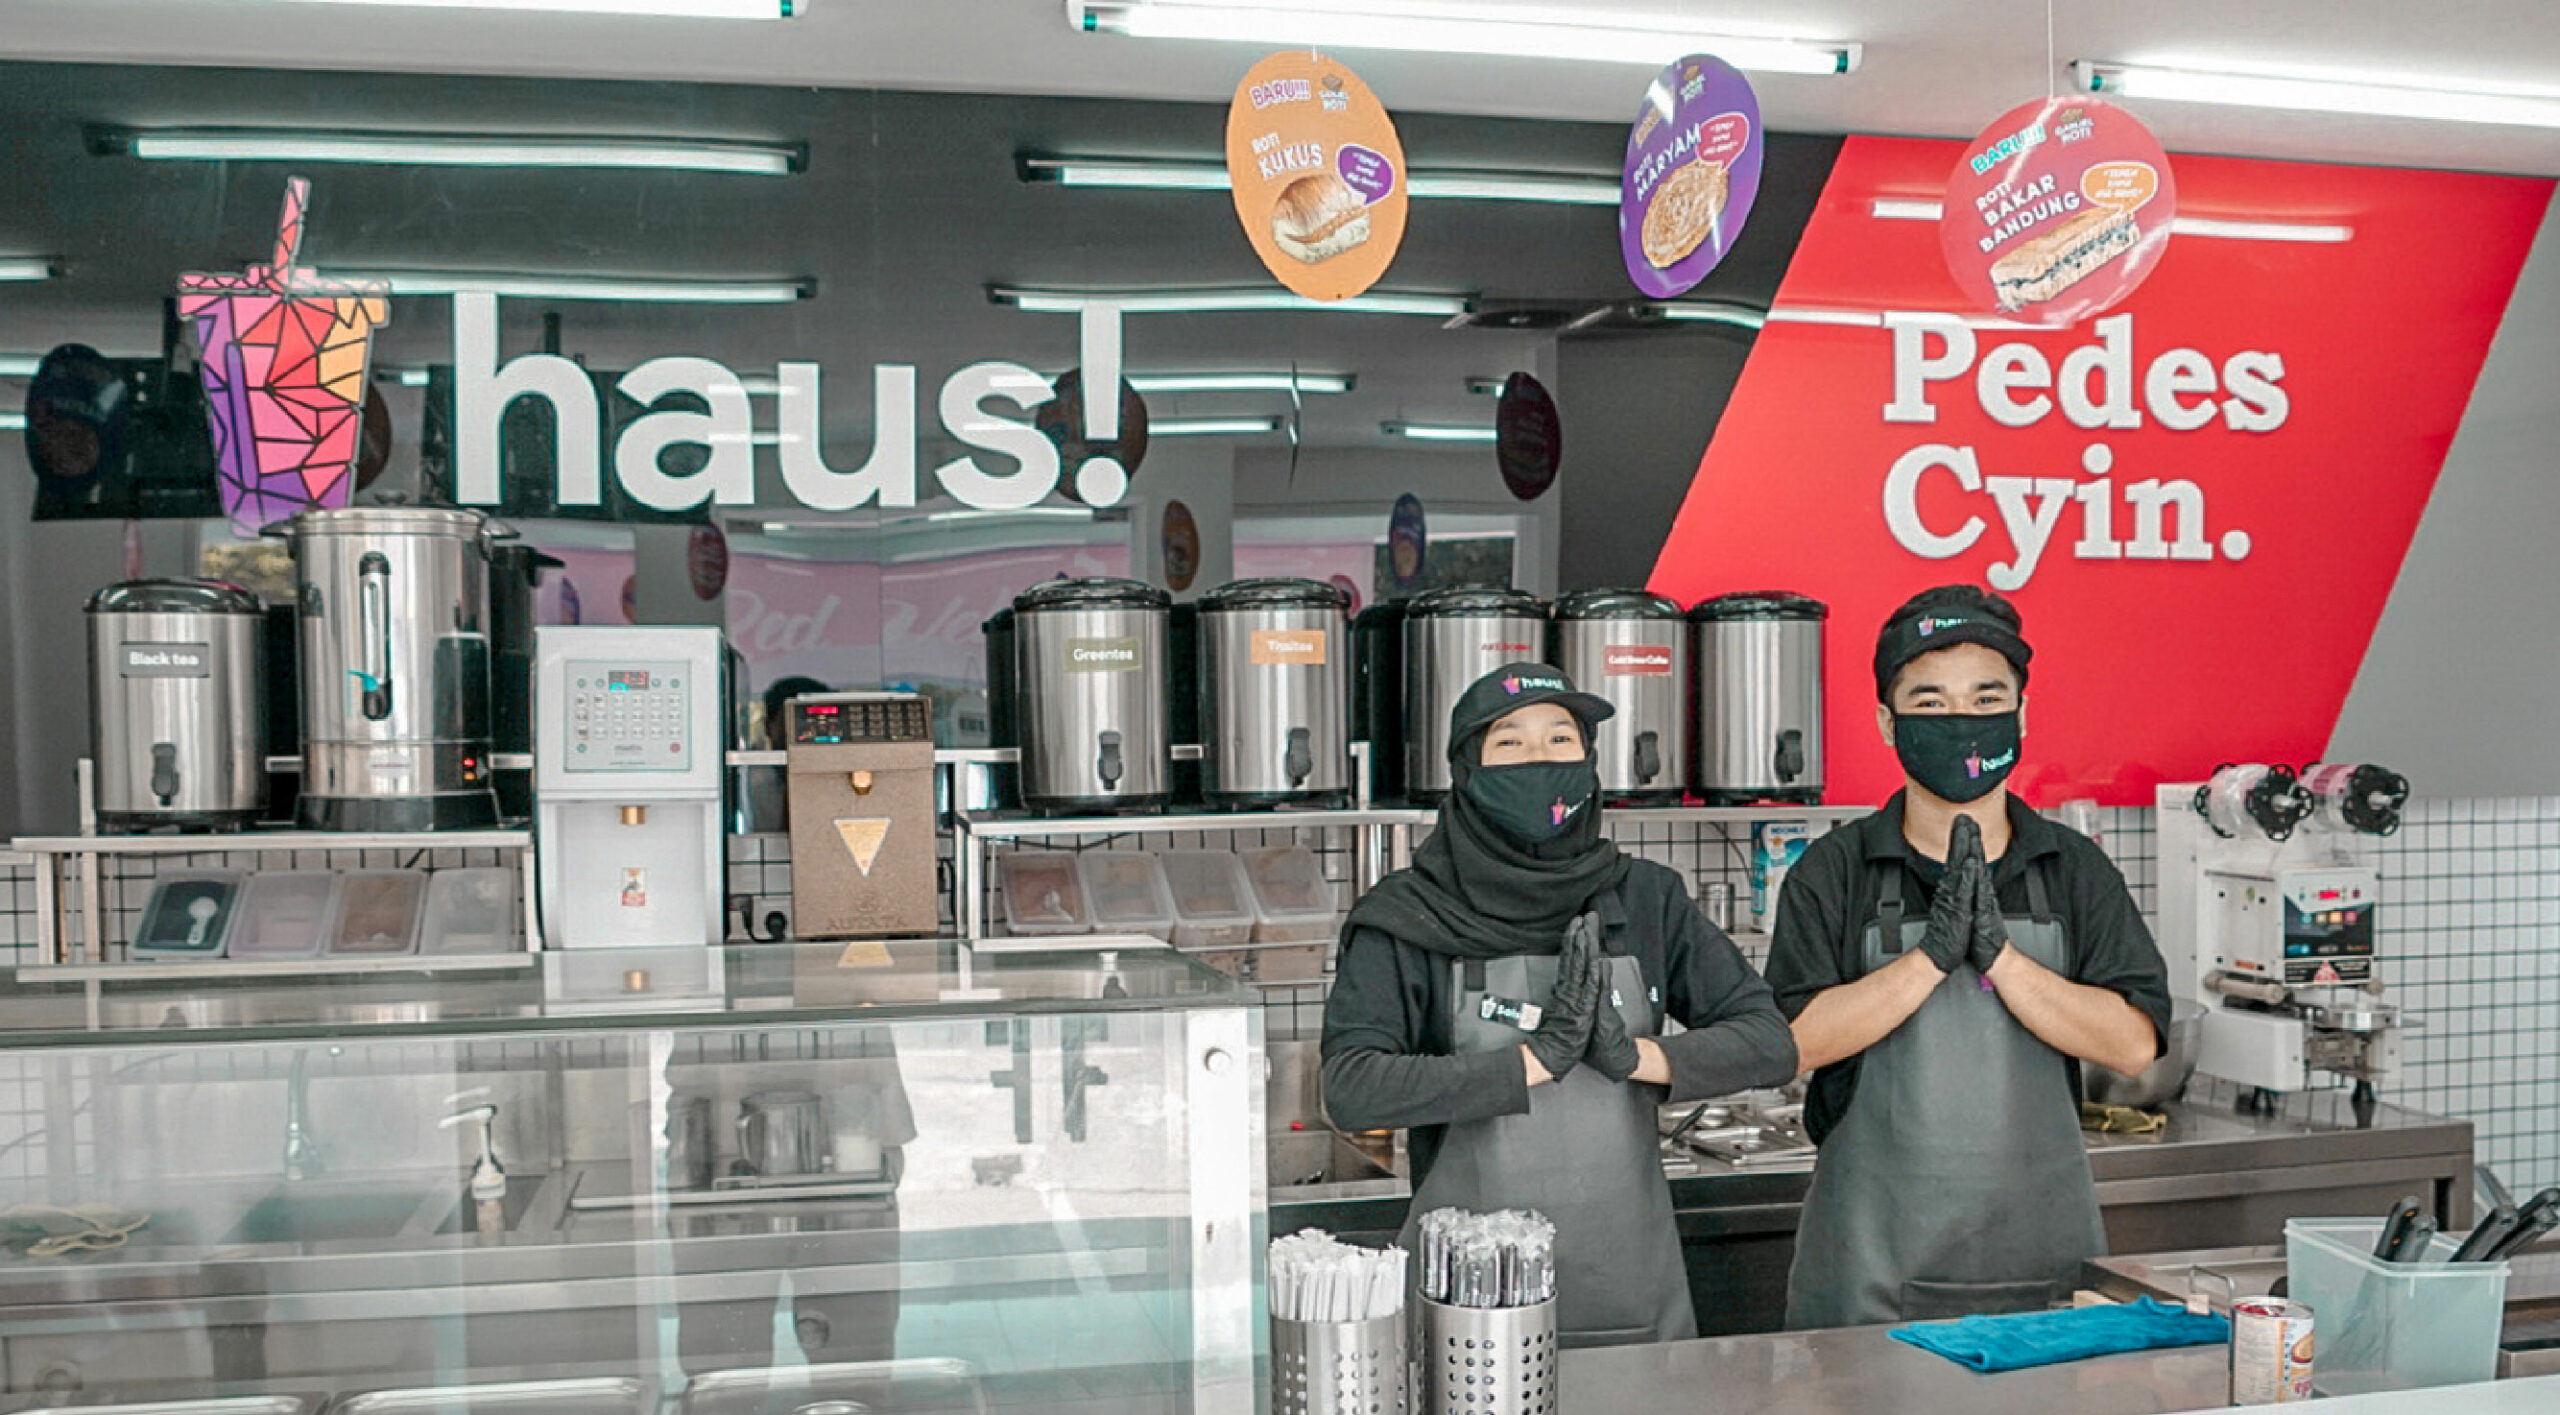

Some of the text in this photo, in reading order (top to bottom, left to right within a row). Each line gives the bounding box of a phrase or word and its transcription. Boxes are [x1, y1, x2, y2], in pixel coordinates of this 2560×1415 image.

[1252, 133, 1279, 154] ROTI
[1259, 144, 1323, 180] KUKUS
[1637, 122, 1701, 201] MARYAM
[1976, 182, 2012, 211] ROTI
[1979, 192, 2080, 252] BANDUNG
[1984, 174, 2056, 226] BAKAR
[1882, 311, 2291, 432] Pedes
[454, 291, 1128, 510] haus!
[1882, 443, 2251, 590] Cyin.
[129, 651, 199, 665] Black tea
[1073, 648, 1133, 661] Greentea
